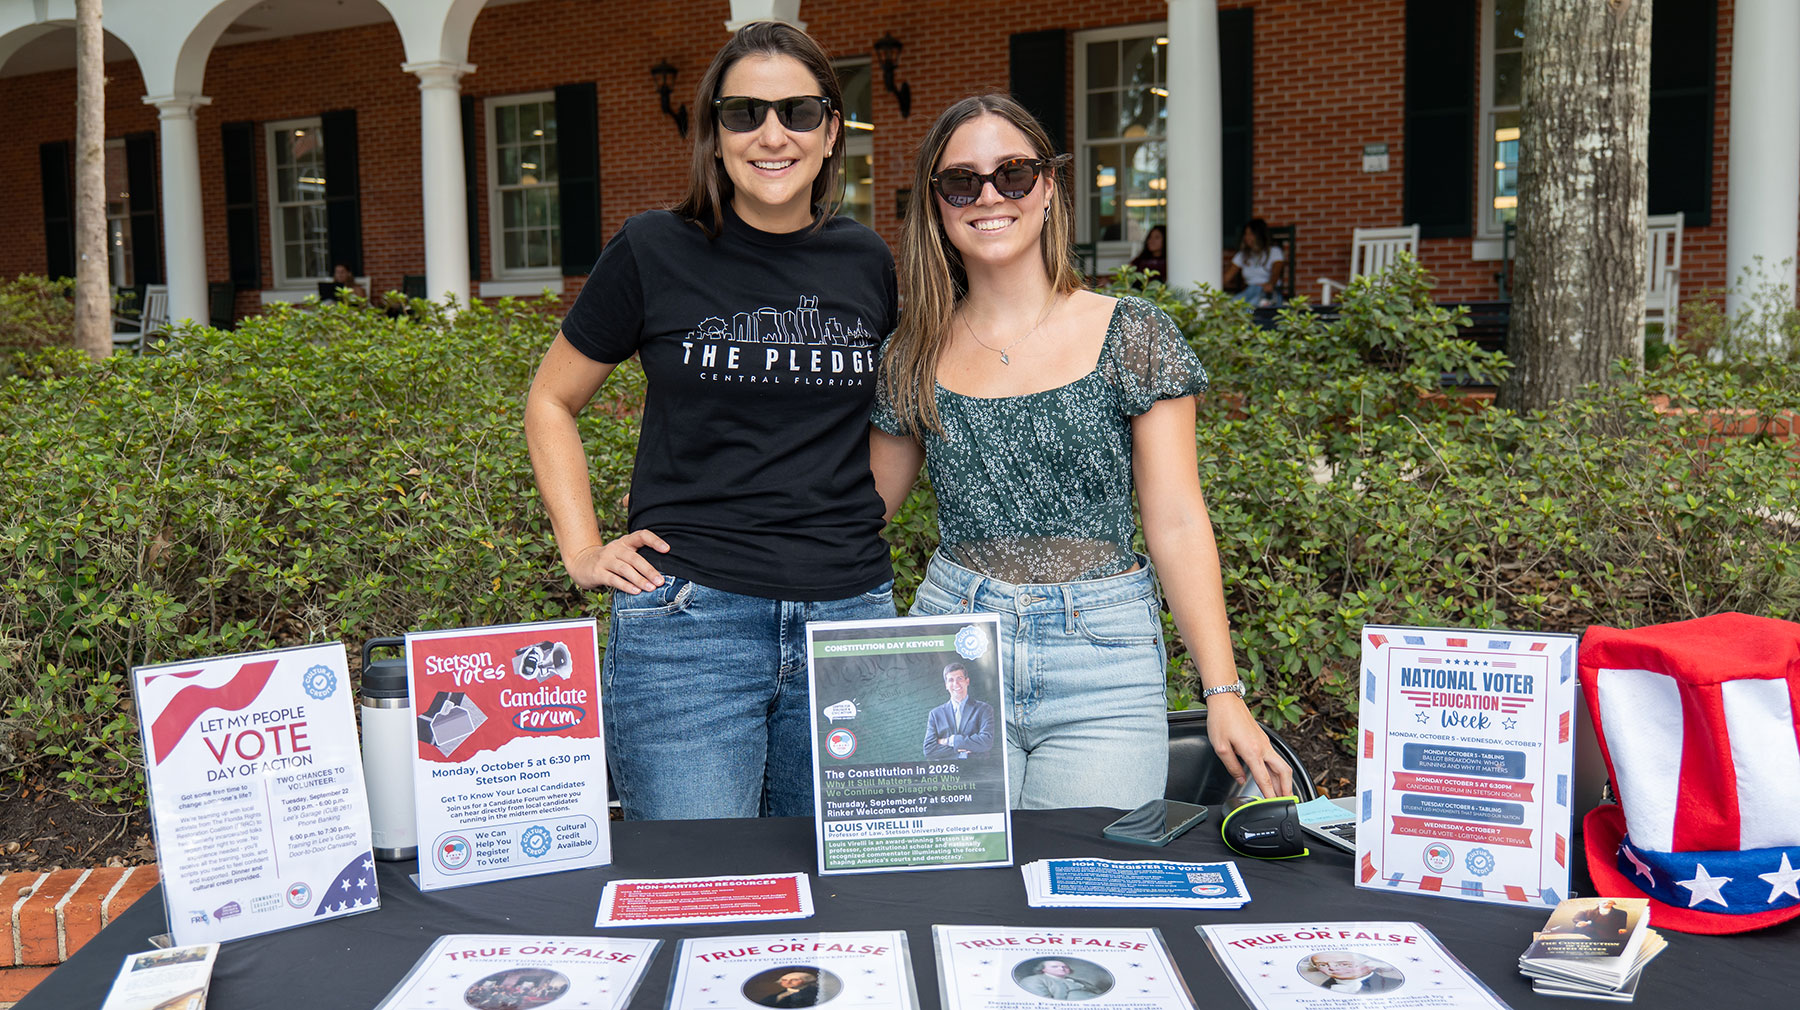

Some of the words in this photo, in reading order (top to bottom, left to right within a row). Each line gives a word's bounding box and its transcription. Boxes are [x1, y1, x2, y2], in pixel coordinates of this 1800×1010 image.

[682, 342, 740, 369] THE
[766, 348, 874, 373] PLEDGE
[700, 373, 779, 384] CENTRAL
[794, 377, 862, 386] FLORIDA
[825, 643, 886, 652] CONSTITUTION
[906, 640, 944, 648] KEYNOTE
[426, 652, 492, 675] Stetson
[305, 668, 334, 683] CULTURAL
[1401, 668, 1477, 690] NATIONAL
[1483, 673, 1534, 694] VOTER
[310, 686, 333, 697] CREDIT
[500, 687, 587, 707] Candidate
[1432, 693, 1499, 711] EDUCATION
[200, 718, 224, 732] LET
[228, 715, 249, 728] MY
[252, 707, 305, 724] PEOPLE
[519, 709, 581, 728] Forum.
[1441, 709, 1492, 730] Week
[203, 721, 311, 764] VOTE
[208, 767, 236, 781] DAY
[240, 763, 258, 776] OF
[262, 754, 312, 769] ACTION
[432, 767, 478, 777] Monday,
[481, 762, 524, 772] October
[528, 759, 534, 767] 5
[536, 758, 548, 766] at
[550, 755, 570, 764] 6:30
[574, 754, 590, 763] pm
[826, 770, 845, 779] The
[848, 768, 914, 777] Constitution
[916, 766, 926, 774] in
[929, 764, 960, 774] 2026:
[276, 776, 294, 784] TWO
[296, 770, 332, 780] CHANCES
[476, 775, 516, 785] Stetson
[520, 771, 550, 780] Room
[826, 781, 846, 789] Why
[858, 779, 875, 788] Still
[878, 778, 911, 786] Matters
[921, 776, 938, 786] And
[940, 775, 960, 785] Why
[288, 779, 336, 790] VOLUNTEER:
[518, 786, 539, 794] Local
[540, 782, 586, 791] Candidates
[826, 789, 841, 797] We
[844, 787, 884, 796] Continue
[887, 786, 896, 794] to
[898, 784, 938, 794] Disagree
[941, 783, 967, 791] About
[970, 782, 976, 790] It
[310, 791, 340, 800] September
[870, 798, 916, 807] September
[556, 822, 586, 832] Cultural
[828, 823, 862, 832] LOUIS
[866, 821, 909, 830] VIRELLI
[912, 820, 923, 828] III
[1424, 823, 1464, 831] WEDNESDAY,
[524, 828, 549, 842] CULTURAL
[556, 832, 580, 840] Credit
[526, 846, 547, 855] CREDIT
[557, 840, 592, 849] Available
[476, 849, 510, 857] Register
[488, 856, 510, 864] Vote!
[636, 882, 712, 890] NON-PARTISAN
[956, 938, 1019, 949] TRUE
[1026, 937, 1063, 945] OR
[1071, 938, 1148, 951] FALSE
[1228, 934, 1291, 949] TRUE
[1295, 931, 1335, 940] OR
[1339, 931, 1417, 944] FALSE
[446, 947, 512, 960] TRUE
[519, 946, 558, 955] OR
[562, 946, 636, 963] FALSE
[696, 947, 761, 963] TRUE
[768, 944, 805, 953] OR
[813, 944, 889, 956] FALSE
